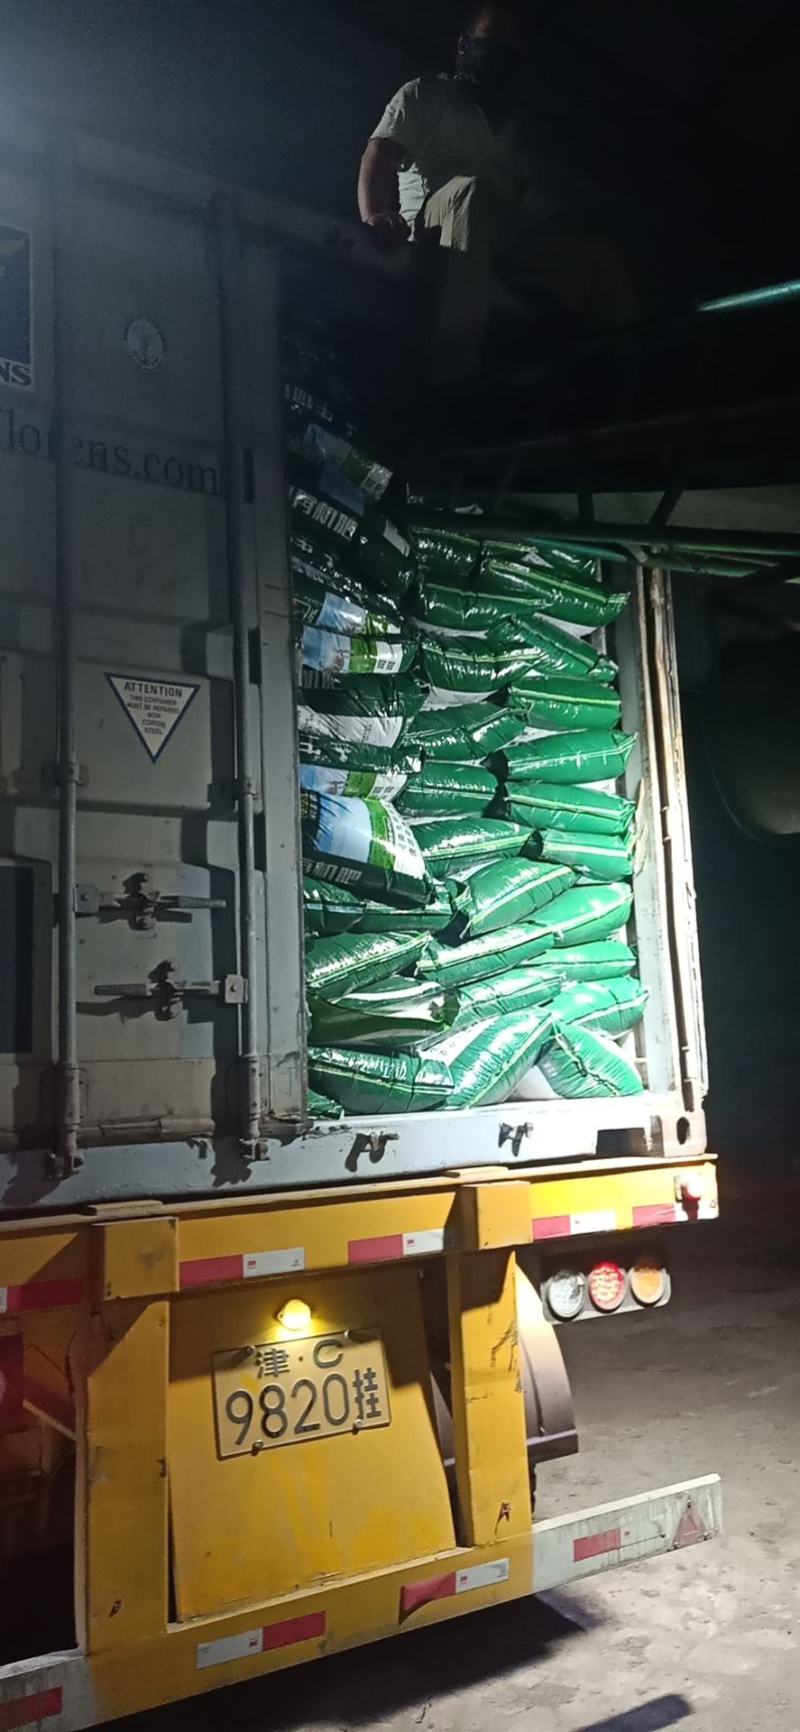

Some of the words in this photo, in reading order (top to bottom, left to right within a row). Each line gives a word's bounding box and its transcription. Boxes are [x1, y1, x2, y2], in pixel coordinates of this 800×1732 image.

[289, 487, 358, 542] 有机肥
[124, 682, 182, 698] ATTENTION
[127, 702, 142, 710] MUST
[144, 696, 177, 706] CONTAINER
[225, 1366, 382, 1445] 9820挂
